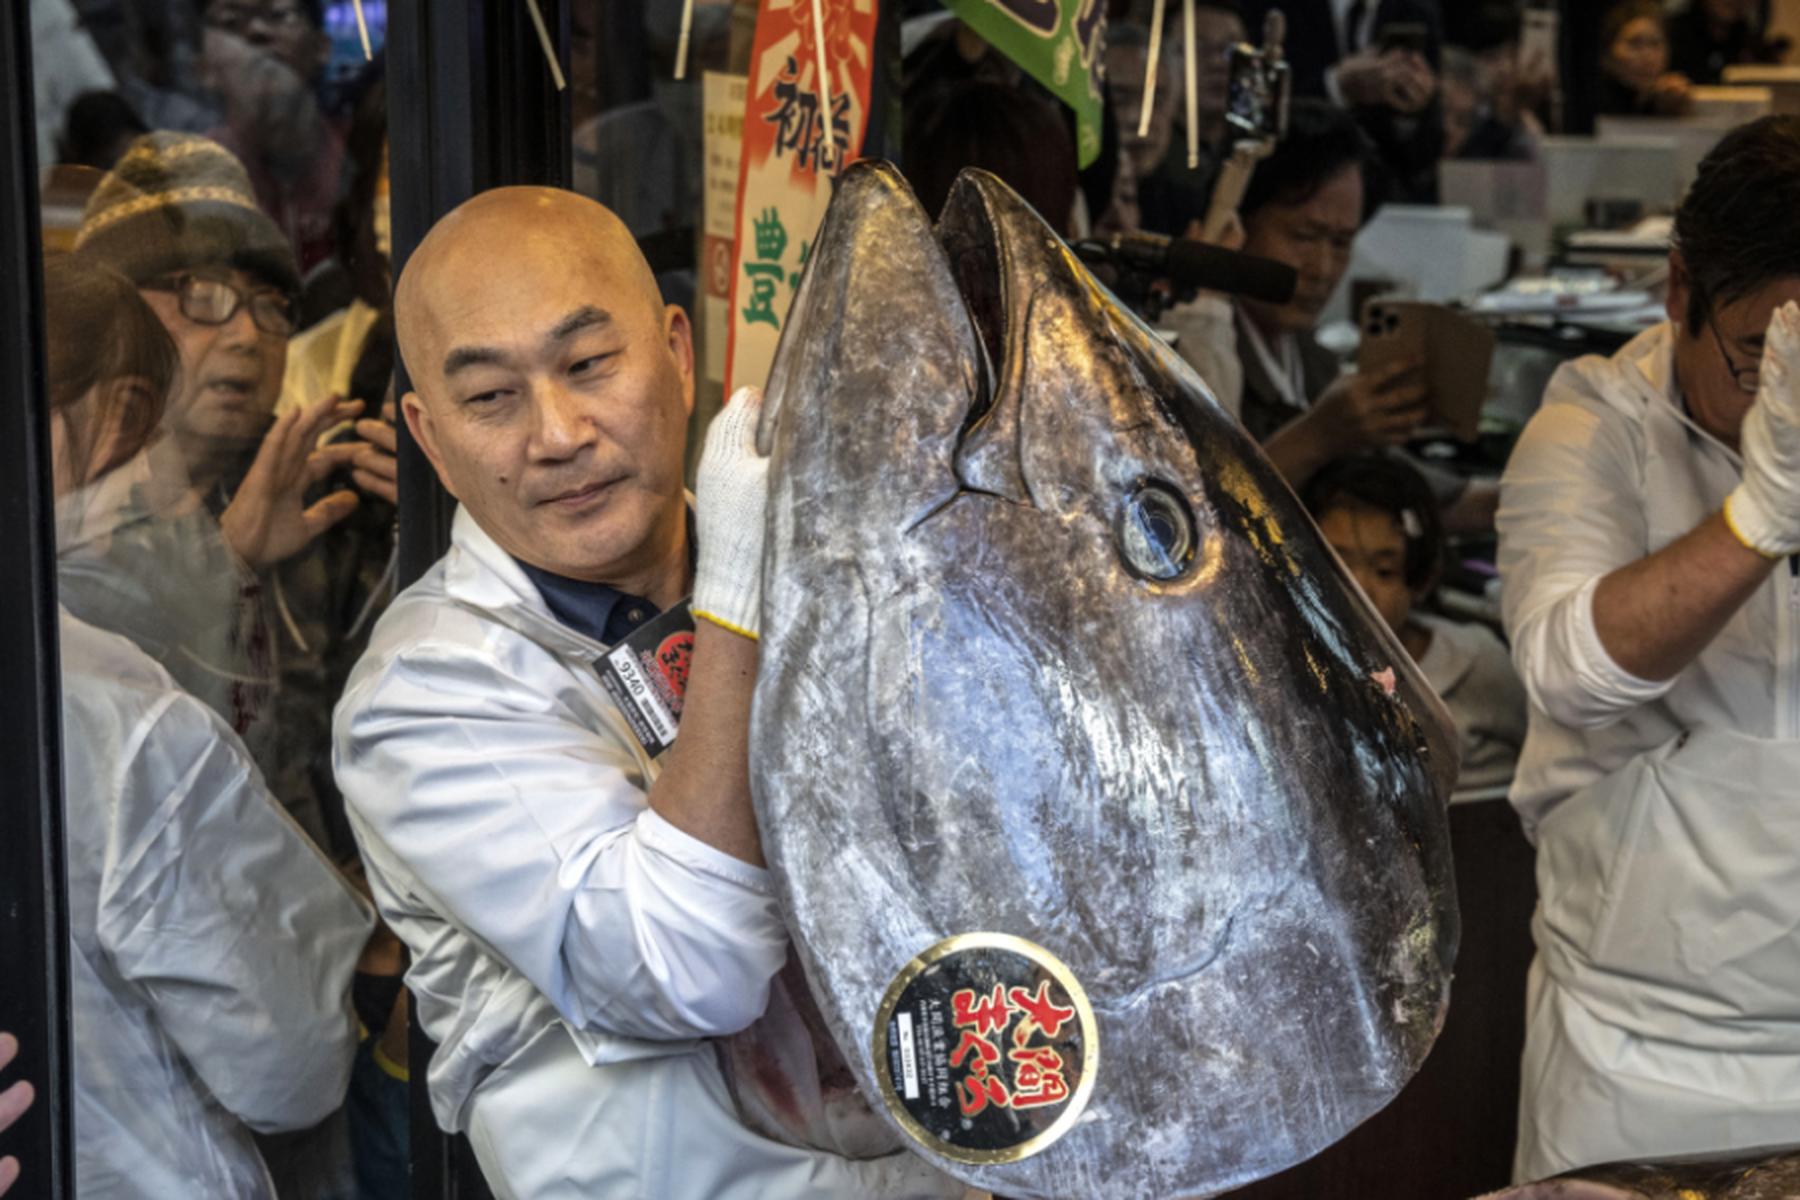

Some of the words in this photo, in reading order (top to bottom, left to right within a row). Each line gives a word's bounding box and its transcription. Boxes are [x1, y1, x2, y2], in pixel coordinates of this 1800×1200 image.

[618, 661, 646, 696] 9340
[952, 983, 1019, 1116] まぐろ
[1009, 981, 1075, 1109] 大間
